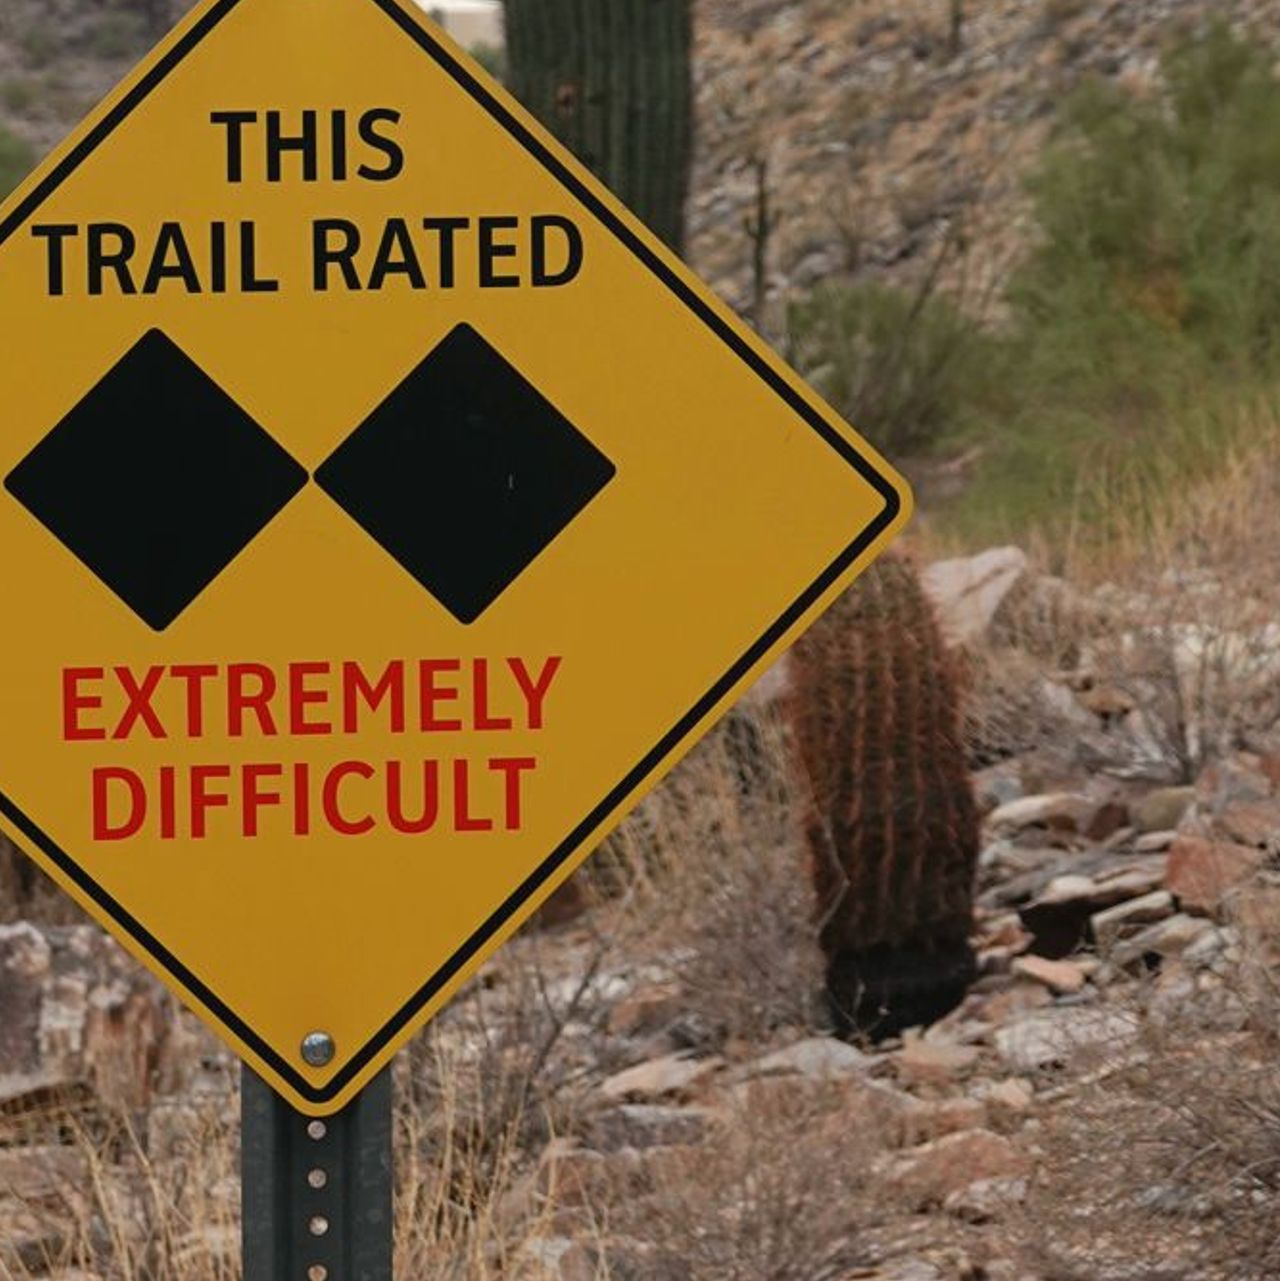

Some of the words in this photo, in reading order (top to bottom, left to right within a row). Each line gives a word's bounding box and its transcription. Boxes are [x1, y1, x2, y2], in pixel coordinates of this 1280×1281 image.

[209, 107, 404, 183] THIS
[31, 219, 280, 297] TRAIL
[311, 214, 585, 292] RATED
[62, 656, 562, 742] EXTREMELY
[92, 757, 536, 841] DIFFICULT
